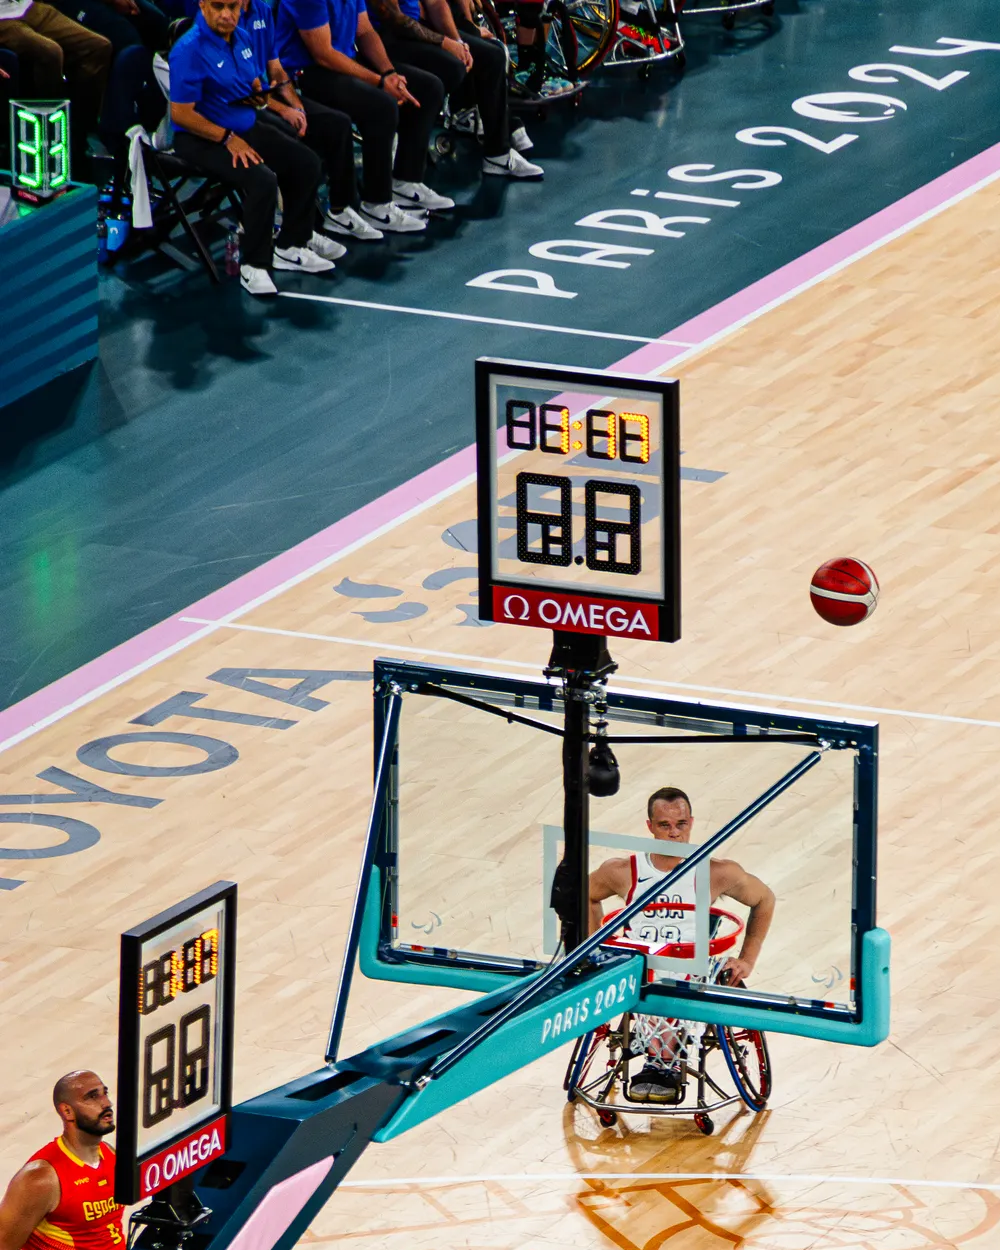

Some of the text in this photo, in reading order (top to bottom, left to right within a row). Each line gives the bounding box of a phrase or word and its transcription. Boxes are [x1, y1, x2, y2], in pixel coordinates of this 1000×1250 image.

[560, 407, 650, 464] 1:17
[538, 598, 651, 635] OMEGA
[0, 666, 377, 890] OYOTA
[593, 974, 637, 1016] 2024
[162, 1128, 222, 1180] OMEGA
